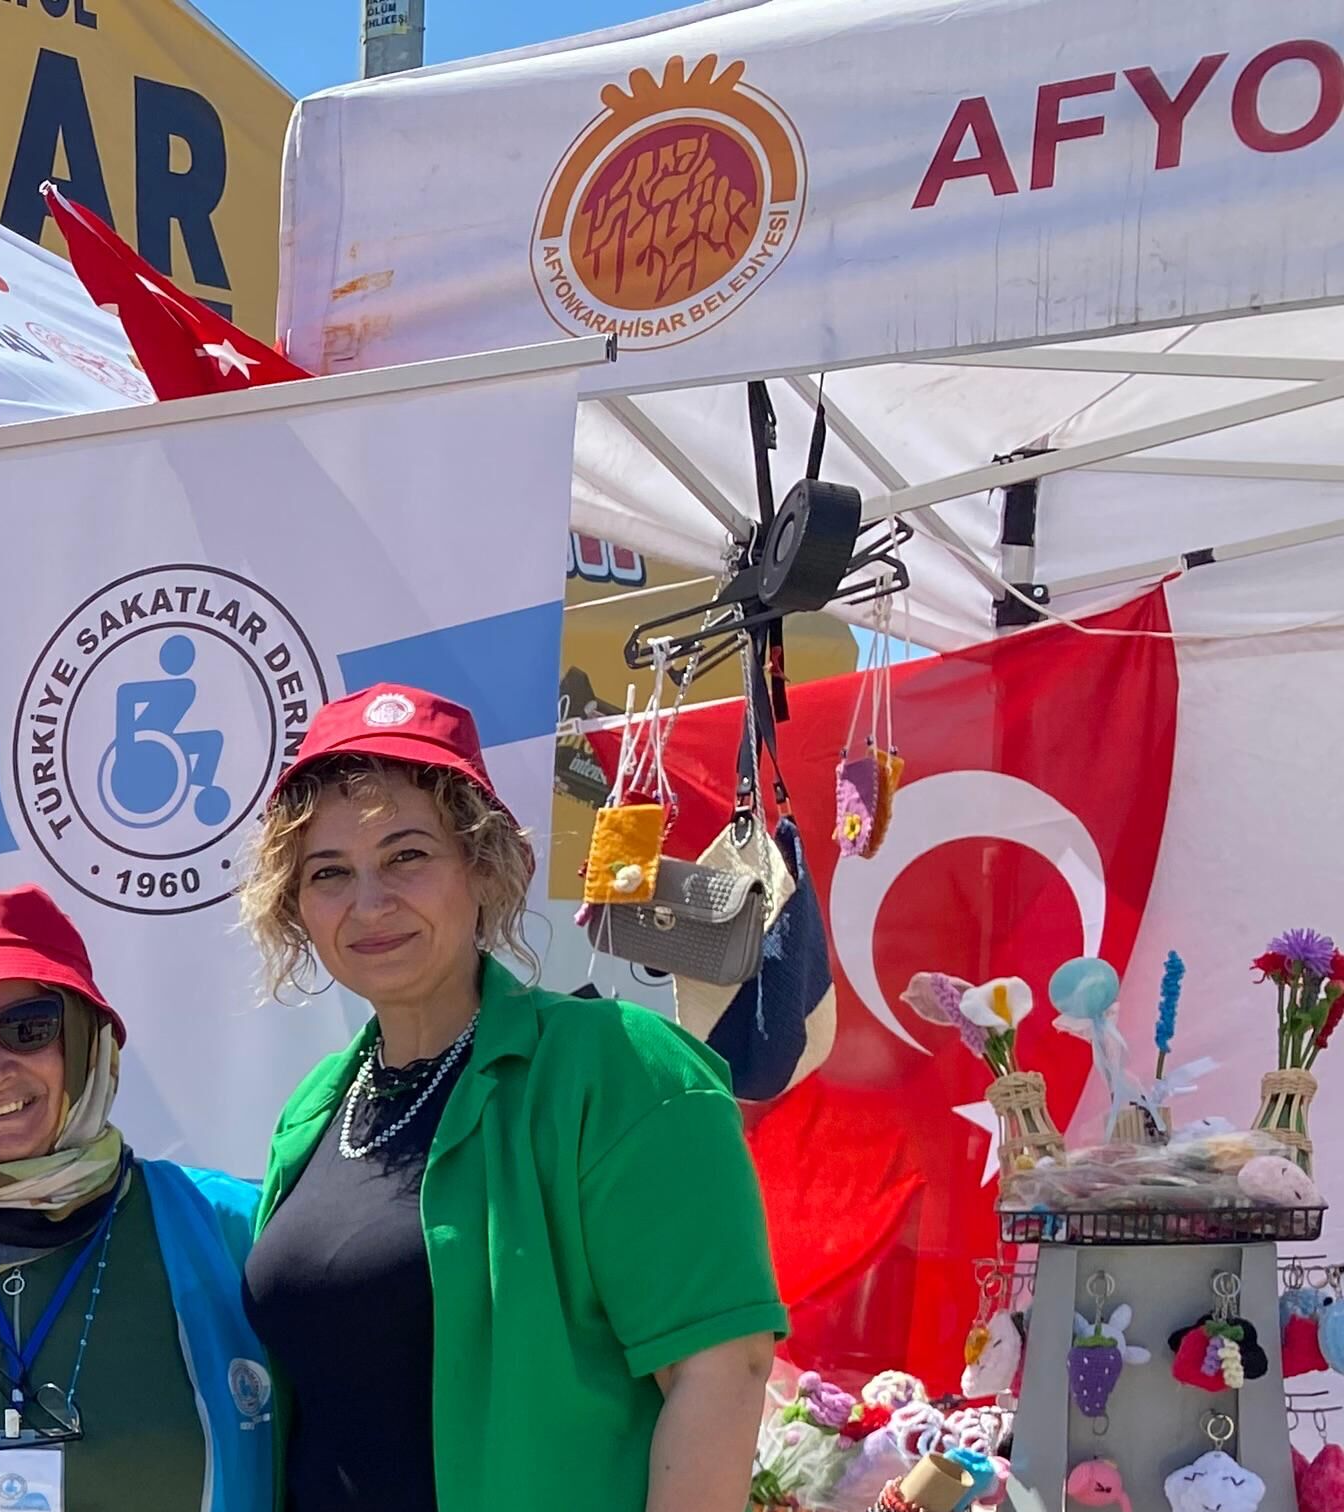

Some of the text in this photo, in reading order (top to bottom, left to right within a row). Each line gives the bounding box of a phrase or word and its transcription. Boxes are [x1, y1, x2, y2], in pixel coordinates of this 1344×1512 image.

[911, 39, 1344, 210] AFYO
[28, 585, 311, 841] TÜRKİYE SAKATLAR DERN
[116, 867, 201, 898] 1960
